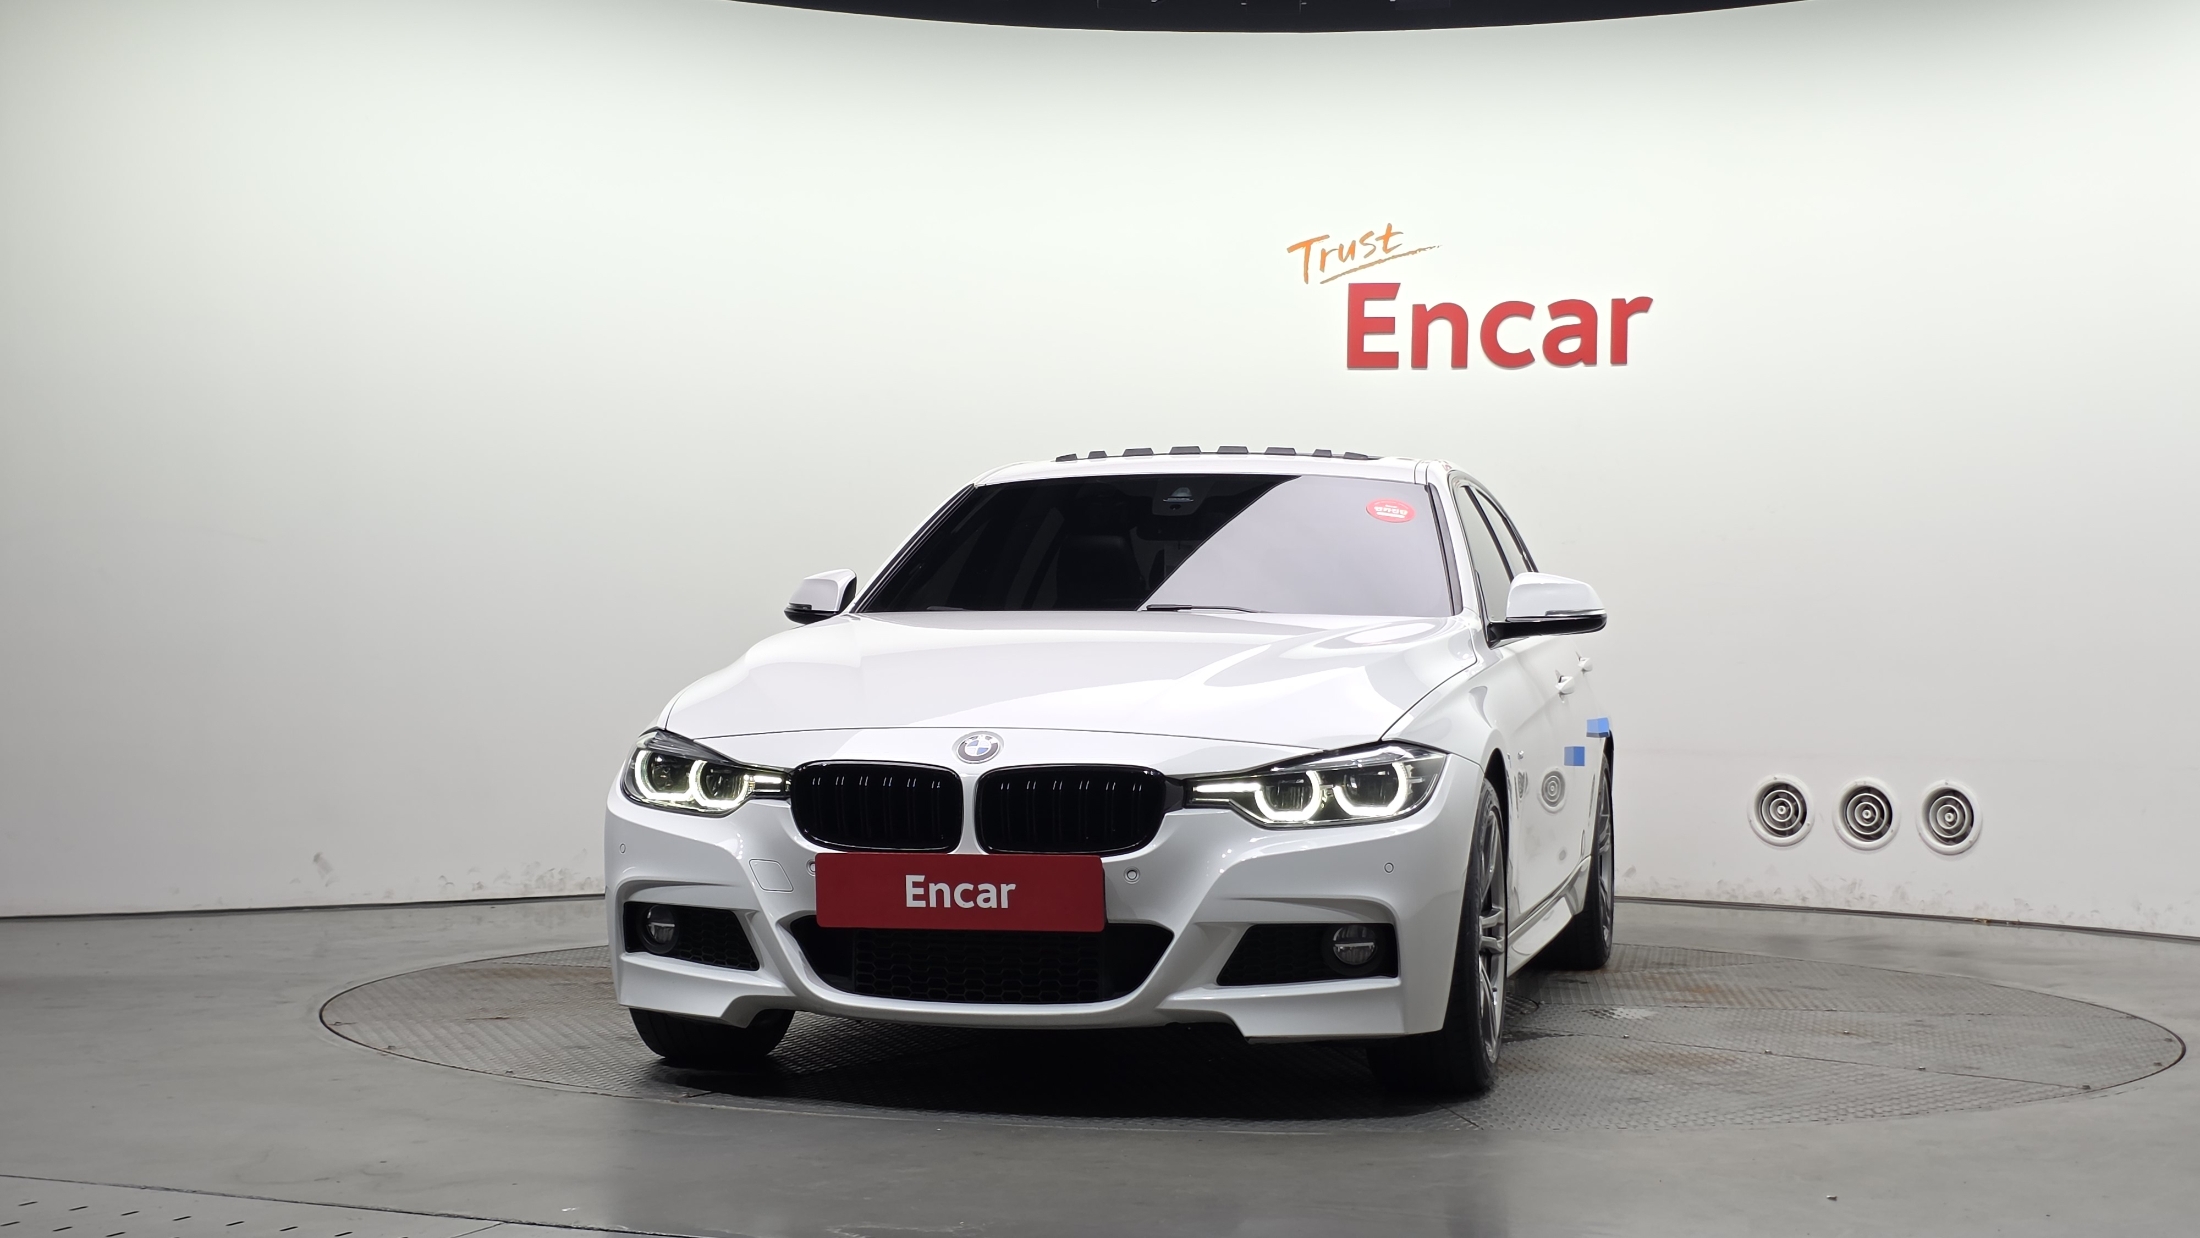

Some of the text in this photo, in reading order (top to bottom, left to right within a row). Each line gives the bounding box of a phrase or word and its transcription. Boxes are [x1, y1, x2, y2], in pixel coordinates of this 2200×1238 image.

[1287, 222, 1404, 285] Trust
[1347, 282, 1654, 370] Encar
[905, 874, 1016, 909] Encar
